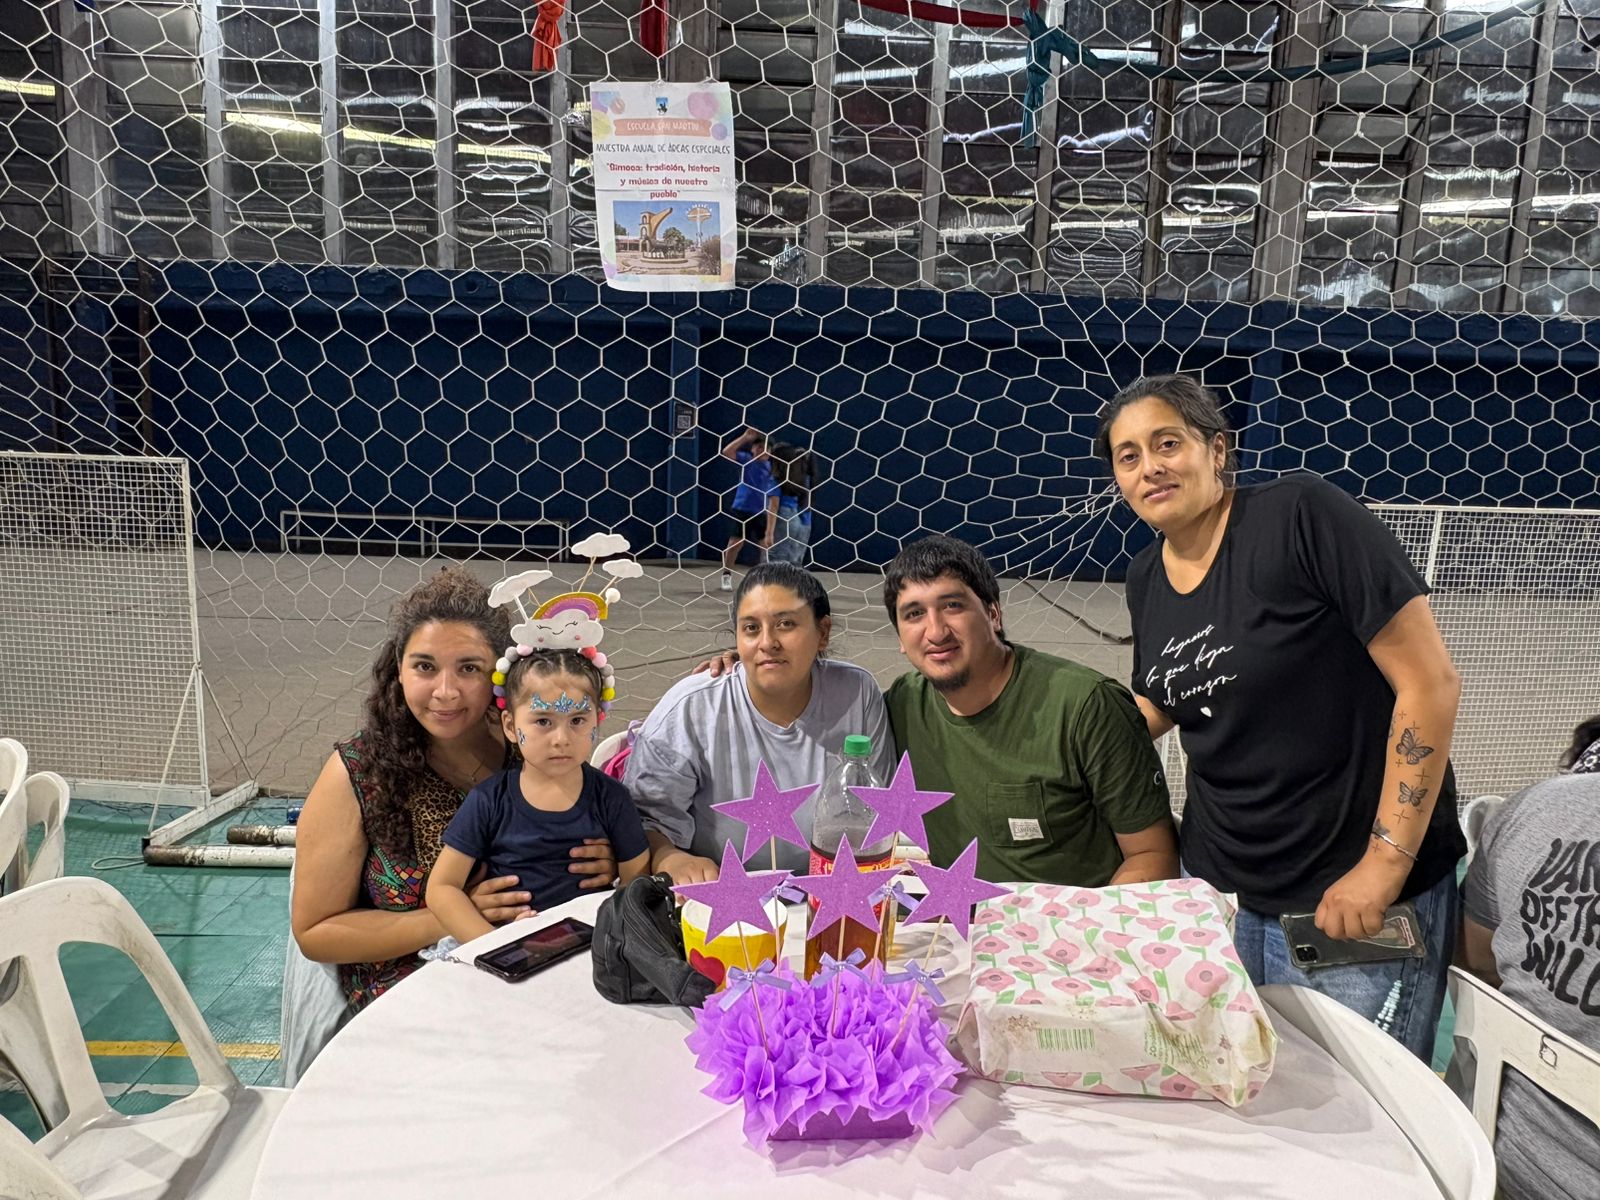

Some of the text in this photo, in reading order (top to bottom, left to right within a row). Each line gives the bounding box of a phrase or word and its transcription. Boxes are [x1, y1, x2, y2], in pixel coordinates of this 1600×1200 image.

[596, 143, 631, 154] MUESTRA
[632, 144, 656, 154] ANUAL
[657, 144, 666, 153] DE
[691, 144, 731, 155] ESPECIALES
[687, 163, 721, 173] historia
[619, 176, 709, 186] y música de nuestro
[1163, 663, 1190, 689] que
[1163, 686, 1176, 707] el
